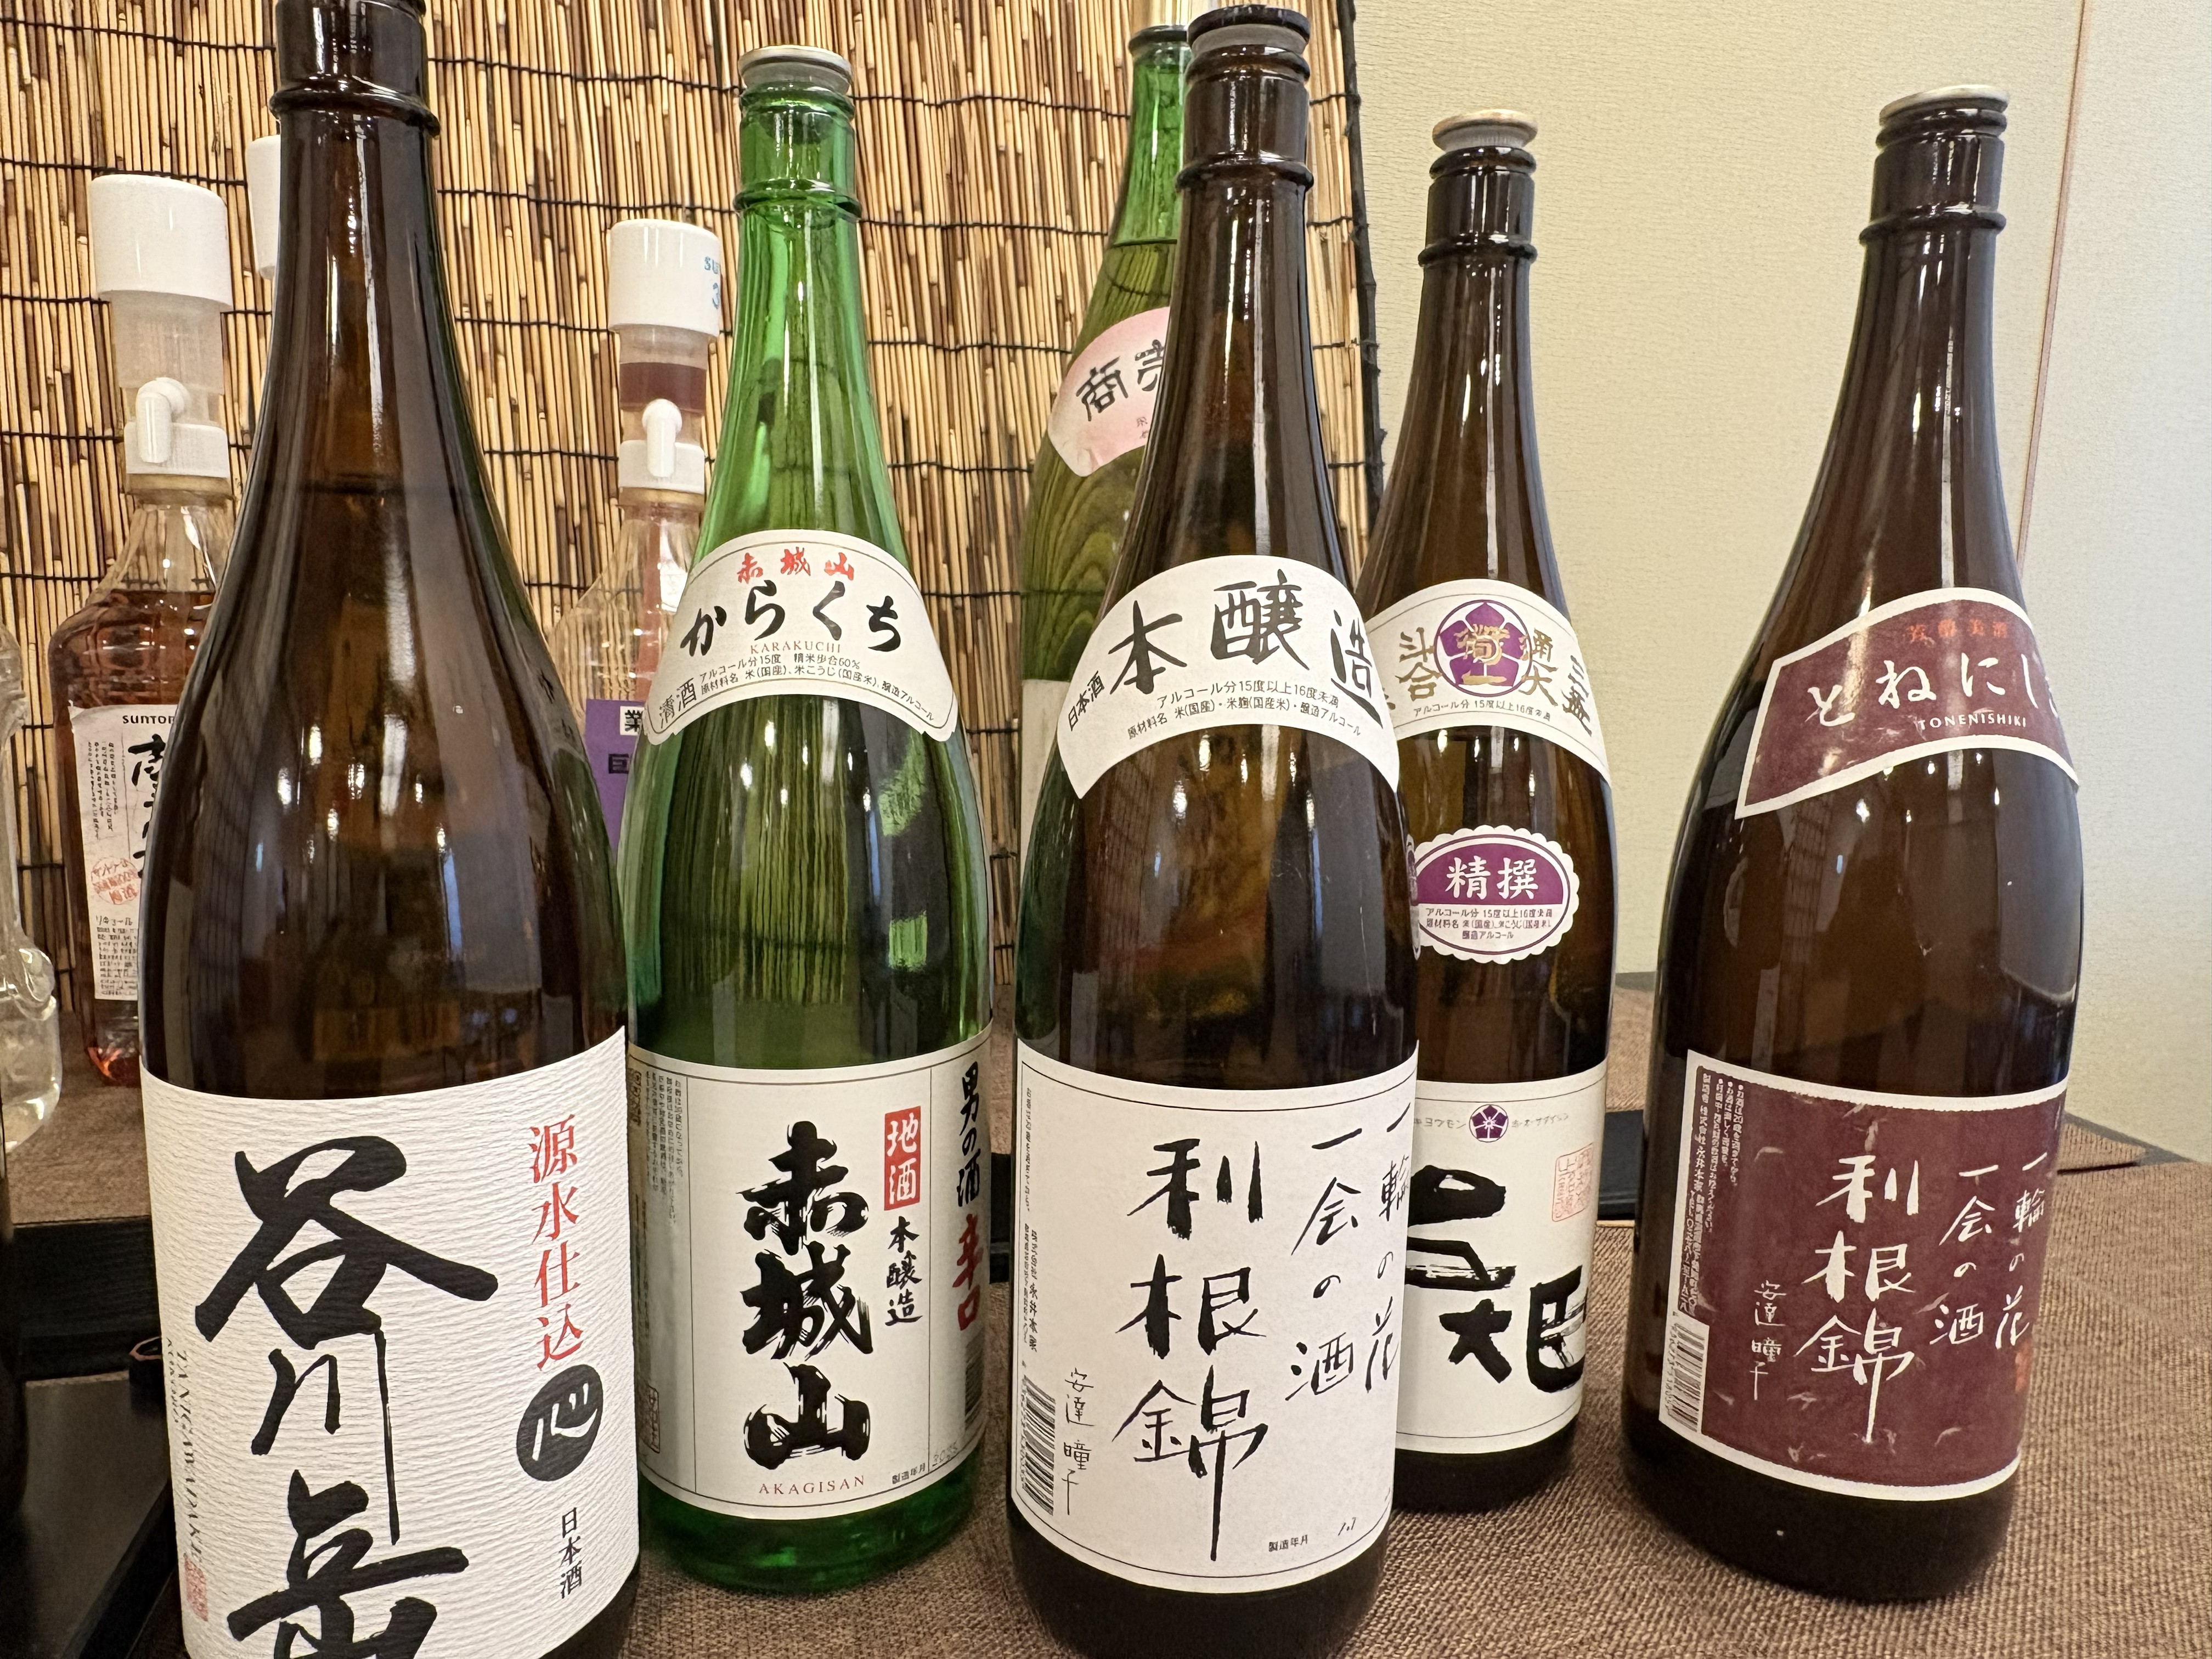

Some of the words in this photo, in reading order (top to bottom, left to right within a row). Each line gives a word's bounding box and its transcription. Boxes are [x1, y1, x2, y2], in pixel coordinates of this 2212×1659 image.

[737, 546, 854, 582] 赤城山
[680, 579, 901, 657] からくち
[750, 640, 841, 654] KARAKUCHI
[1108, 569, 1383, 729] 本醸造
[659, 678, 697, 729] 清酒
[1068, 671, 1105, 731] 日本酒
[1917, 713, 2027, 730] TONENISHIKI
[1445, 855, 1539, 900] 精撰
[887, 1112, 920, 1205] 地酒
[958, 1062, 981, 1207] 男の酒
[529, 1114, 583, 1370] 源水仕込
[885, 1216, 923, 1326] 本醸造
[1285, 1128, 1363, 1401] 一会の酒
[1929, 1165, 1999, 1345] 一会の酒
[1995, 1153, 2048, 1350] 一輪の花
[736, 1121, 873, 1470] 赤城山
[1793, 1155, 1920, 1443] 利根錦
[1112, 1138, 1267, 1562] 利根錦
[759, 1476, 866, 1495] AKAGISAN
[559, 1507, 583, 1599] 日本酒
